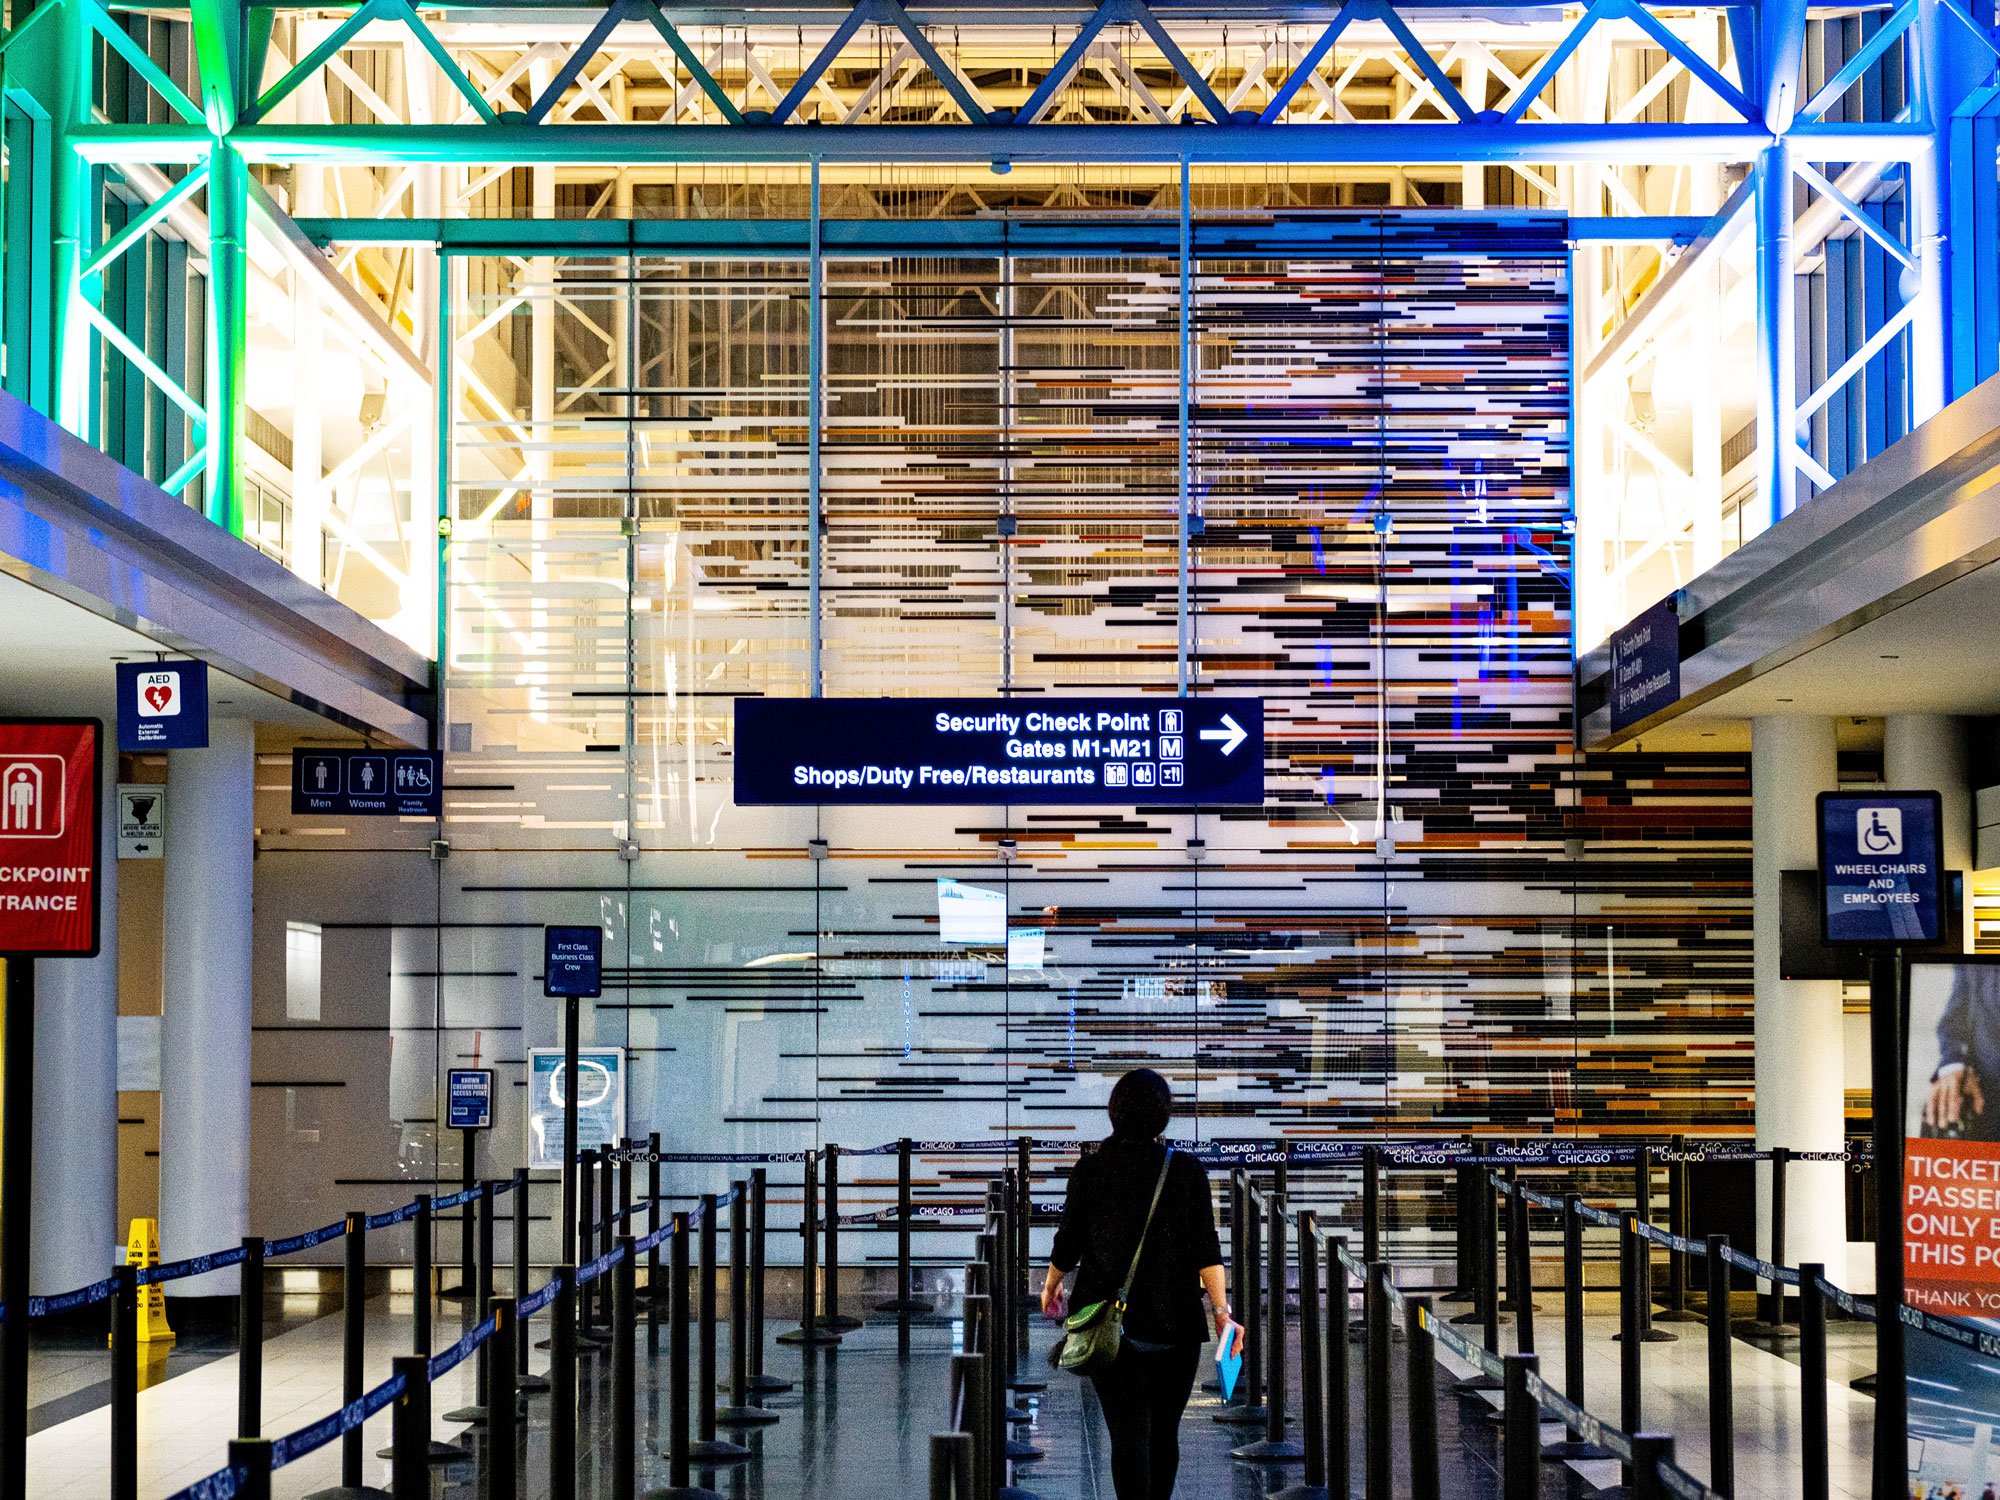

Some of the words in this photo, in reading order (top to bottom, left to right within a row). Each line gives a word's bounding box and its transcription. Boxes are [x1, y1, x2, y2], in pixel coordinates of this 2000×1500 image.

[148, 674, 170, 684] AED
[935, 712, 1021, 736] Security
[1026, 712, 1091, 731] Check
[1096, 712, 1150, 731] Point
[1006, 739, 1066, 759] Gates
[1071, 740, 1152, 758] M1-M21
[794, 765, 914, 788] Shops/Duty
[919, 765, 1096, 785] Free/Restaurants
[310, 799, 331, 807] Men
[349, 799, 386, 808] Women
[1835, 864, 1927, 874] WHEELCHAIRS
[1868, 879, 1895, 889] AND
[1843, 893, 1920, 903] EMPLOYEES
[920, 1141, 955, 1150] CHICAGO
[1220, 1144, 1256, 1153] CHICAGO
[1297, 1143, 1343, 1151] CHICAGO
[1496, 1147, 1544, 1156] CHICAGO
[607, 1152, 659, 1163] CHICAGO
[689, 1154, 735, 1162] INTERNATIONAL
[1245, 1152, 1287, 1163] CHICAGO
[1311, 1151, 1347, 1159] INTERNATIONAL
[1393, 1154, 1446, 1164] CHICAGO
[1557, 1154, 1610, 1164] CHICAGO
[1660, 1152, 1705, 1162] CHICAGO
[1800, 1152, 1851, 1162] CHICAGO
[919, 1206, 954, 1215] CHICAGO
[1906, 1213, 1980, 1237] ONLY
[1905, 1242, 1966, 1266] THIS
[1904, 1288, 1971, 1307] THANK
